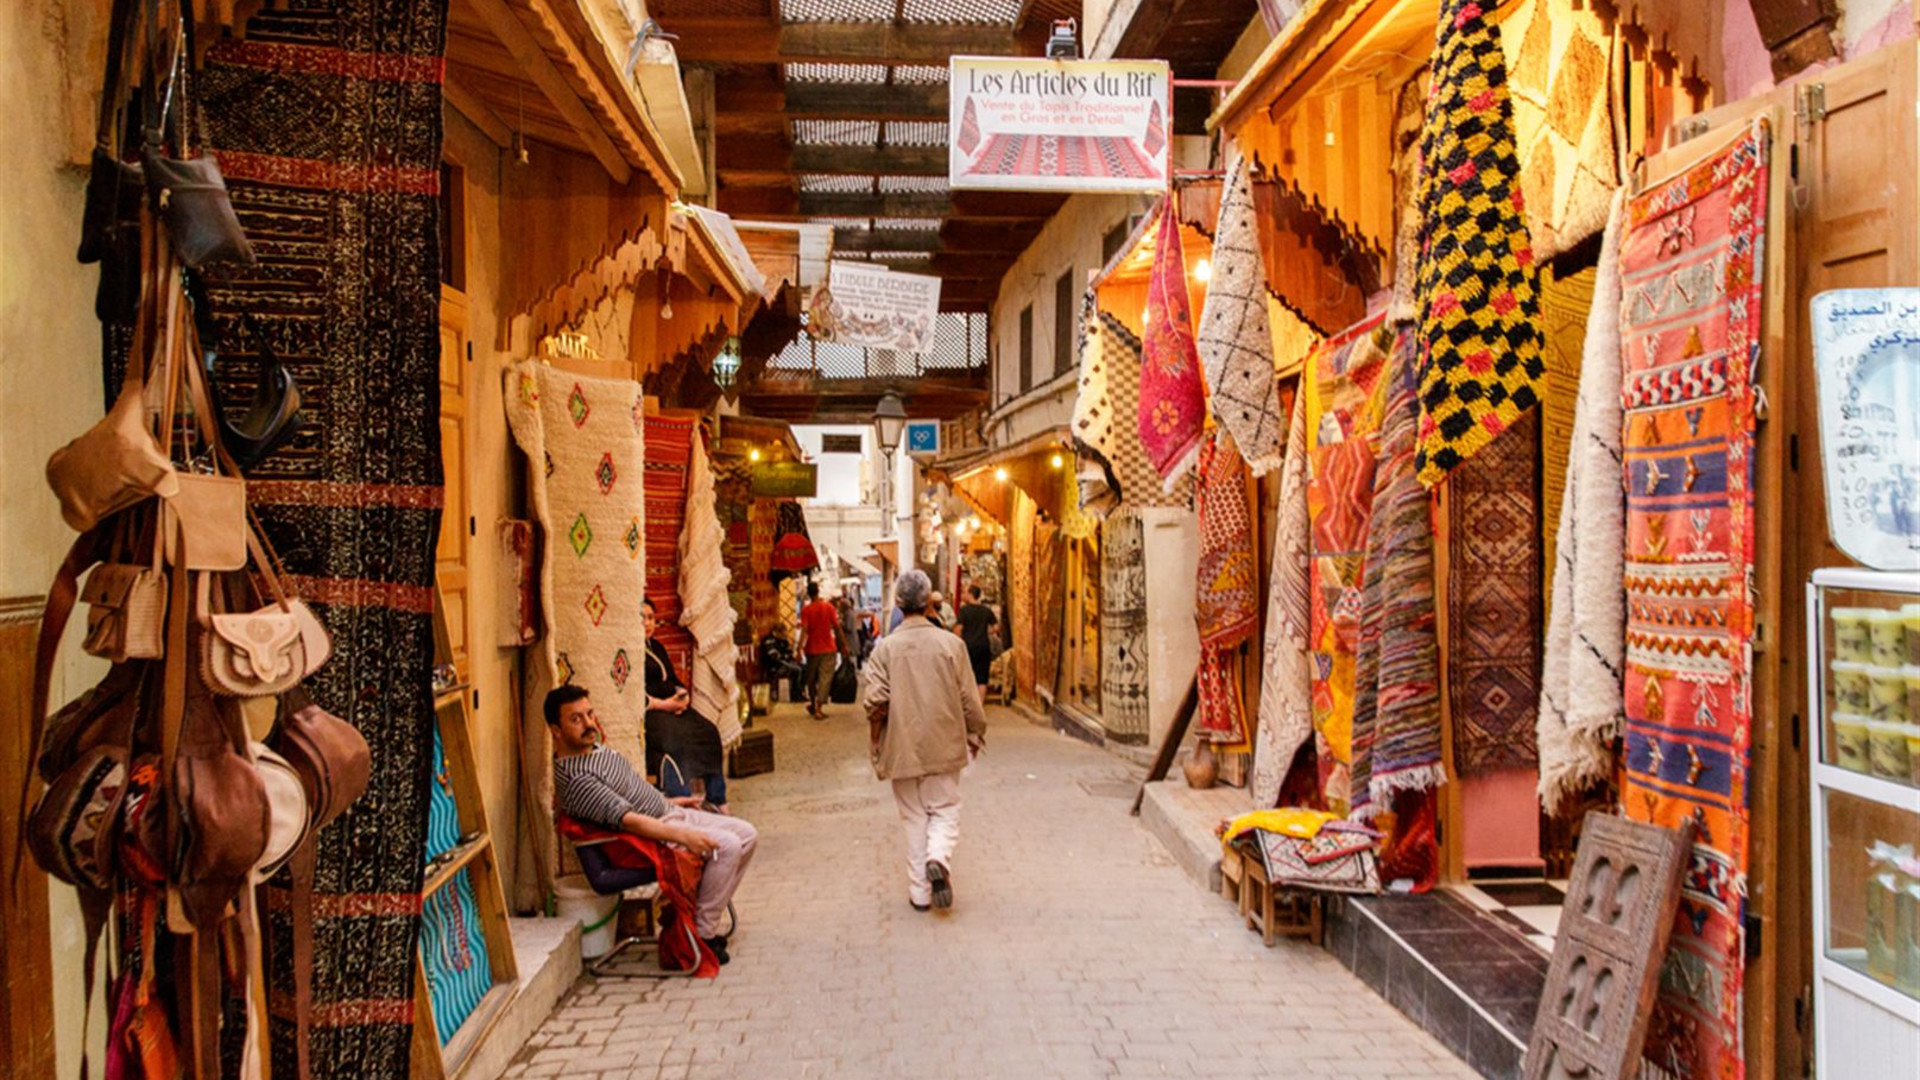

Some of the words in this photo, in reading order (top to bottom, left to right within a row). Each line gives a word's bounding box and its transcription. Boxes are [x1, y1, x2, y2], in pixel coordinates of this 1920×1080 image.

[970, 68, 1003, 97] Les
[1010, 69, 1088, 99] Articles
[1094, 71, 1119, 97] du
[1127, 71, 1157, 98] Rif
[980, 99, 1015, 110] Vente
[1020, 101, 1035, 111] du
[1040, 101, 1070, 113] Tapis
[1074, 101, 1144, 114] Traditionnel
[1001, 113, 1016, 122] en
[1020, 111, 1049, 123] Gros
[1053, 114, 1065, 123] et
[1069, 115, 1083, 124] en
[1828, 301, 1892, 322] الصديق
